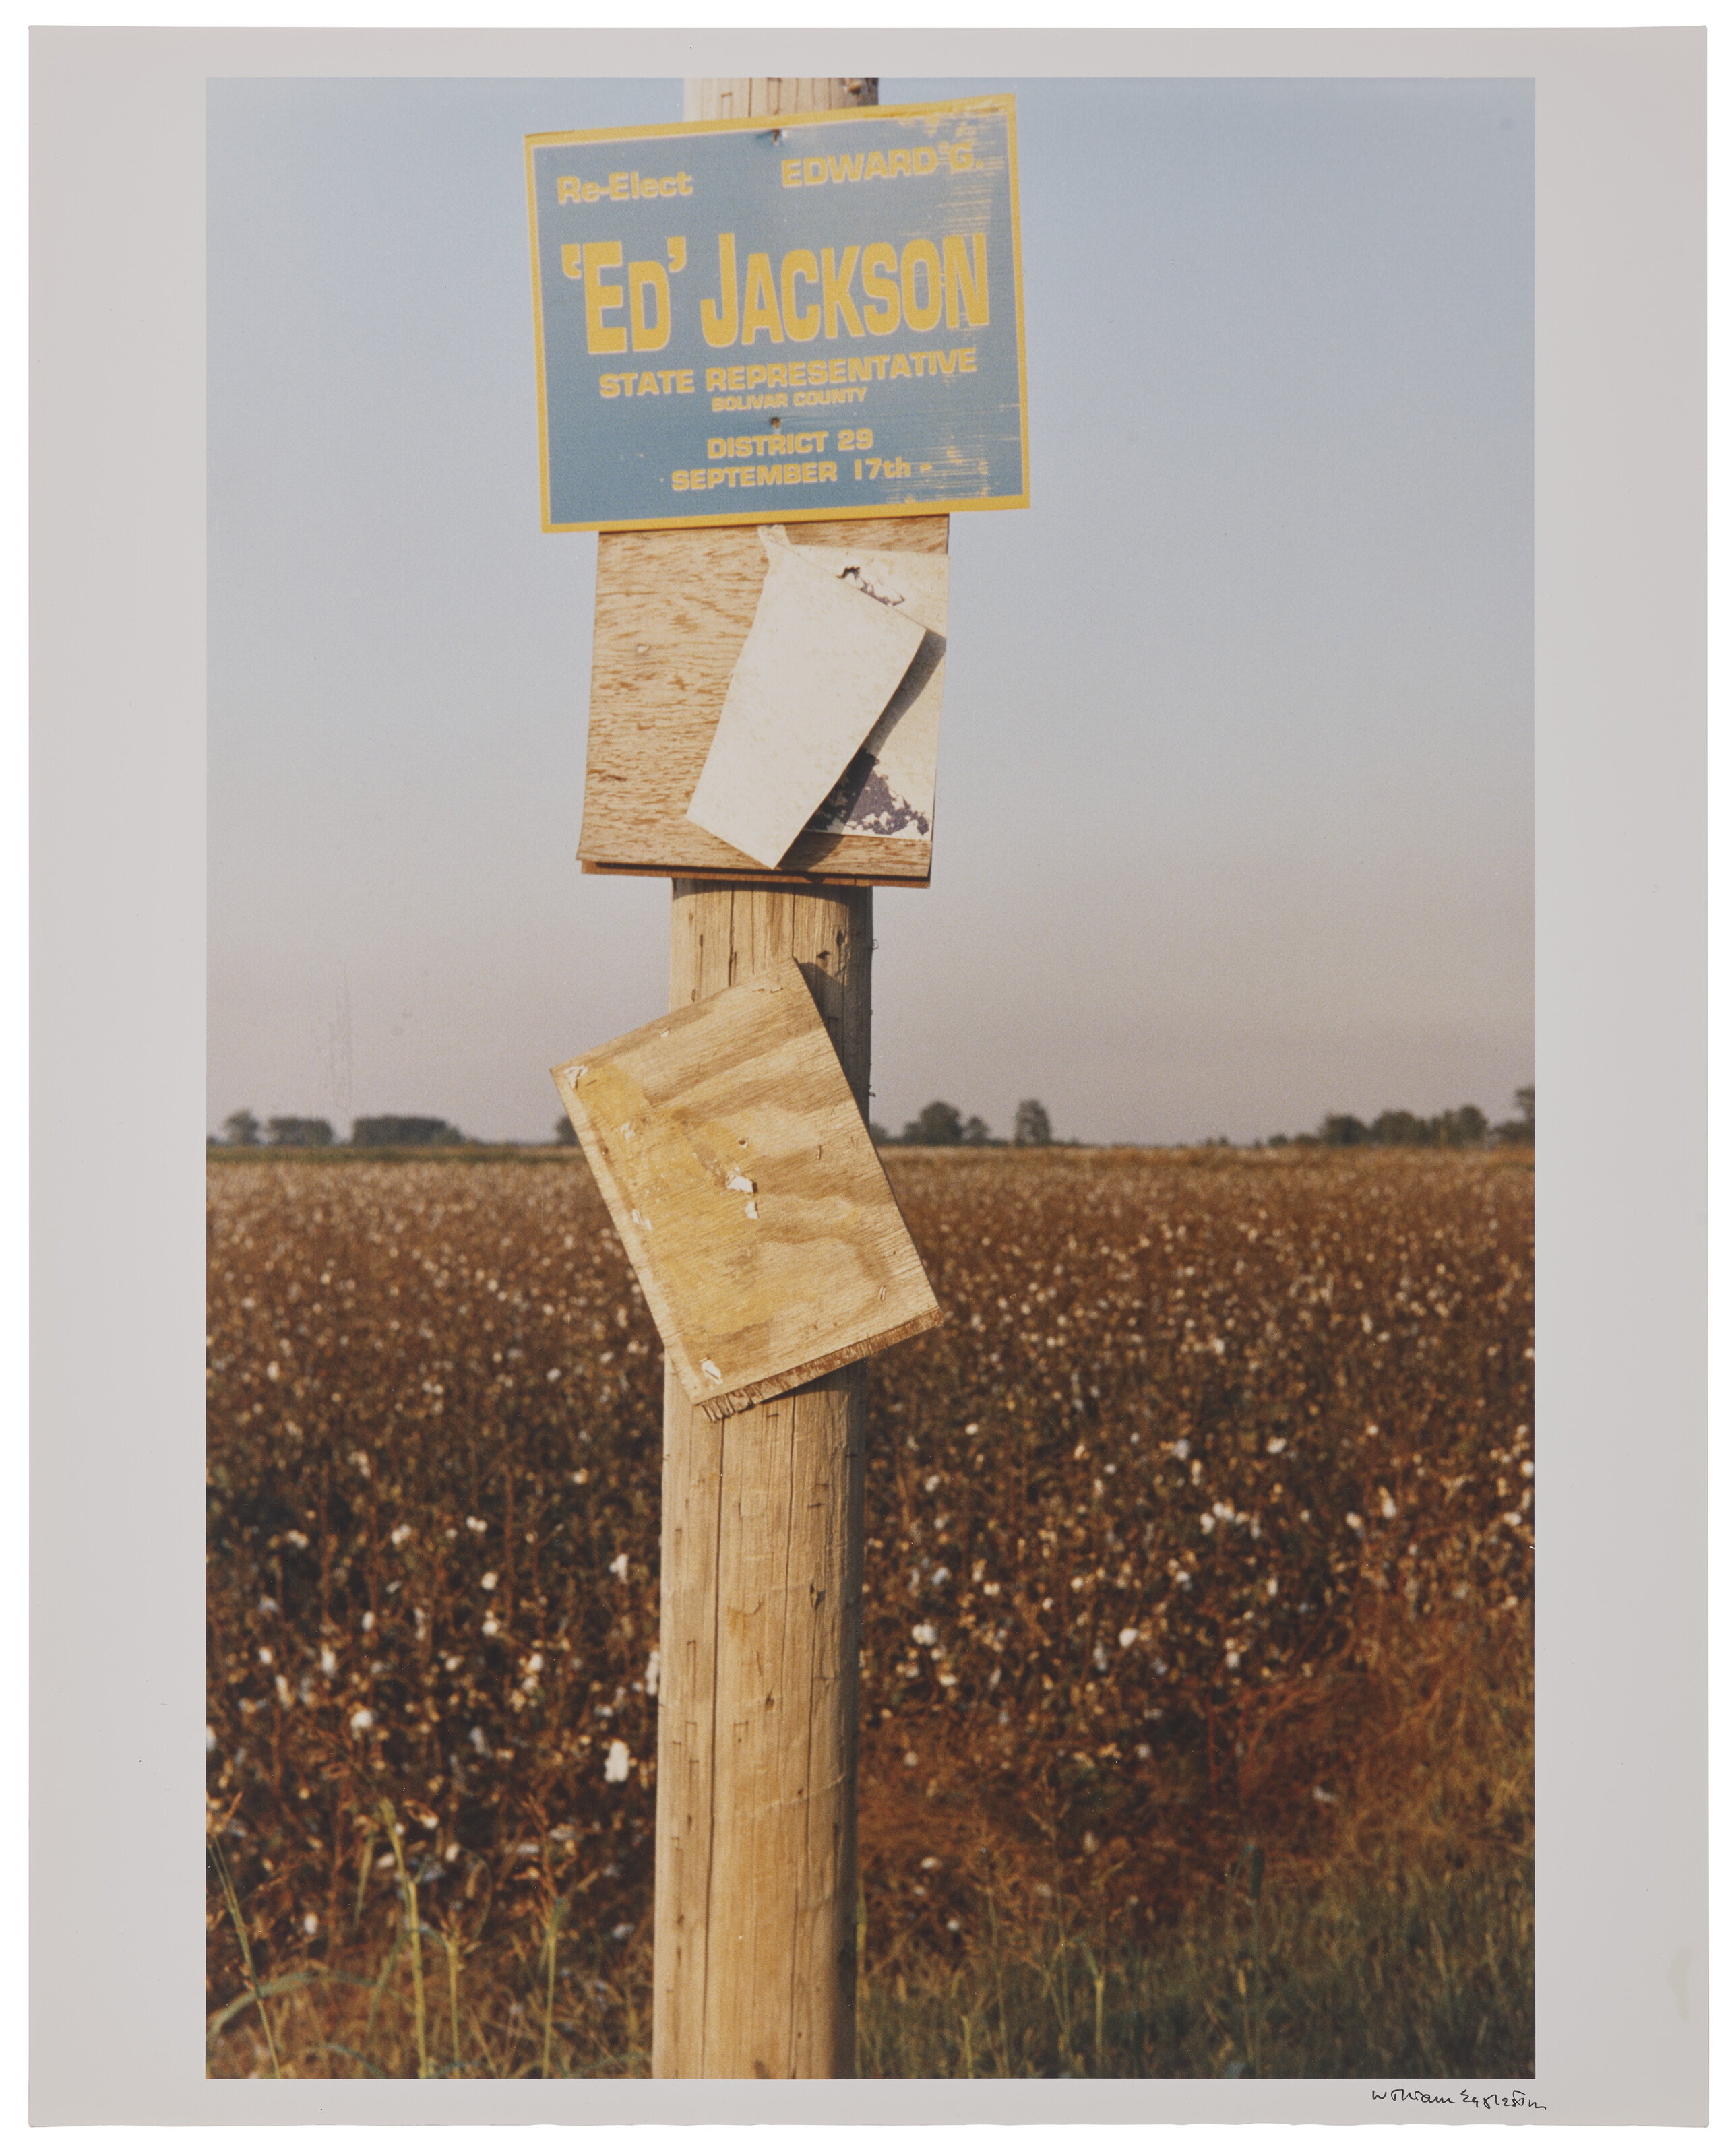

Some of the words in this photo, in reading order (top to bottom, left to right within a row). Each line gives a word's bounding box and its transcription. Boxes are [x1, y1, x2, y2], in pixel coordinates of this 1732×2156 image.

[780, 145, 938, 189] EDWARD
[949, 140, 984, 175] G.
[557, 170, 694, 205] Re-Elect
[700, 231, 990, 348] JACKSON
[599, 368, 695, 399] STATE
[705, 347, 978, 393] REPRESENTATIVE
[711, 393, 789, 412] BOLIVAR
[793, 387, 868, 406] COUNTY
[707, 431, 829, 460] DISTRICT
[837, 428, 875, 452] 29
[671, 460, 838, 493] SEPTEMBER
[854, 456, 912, 481] 17th
